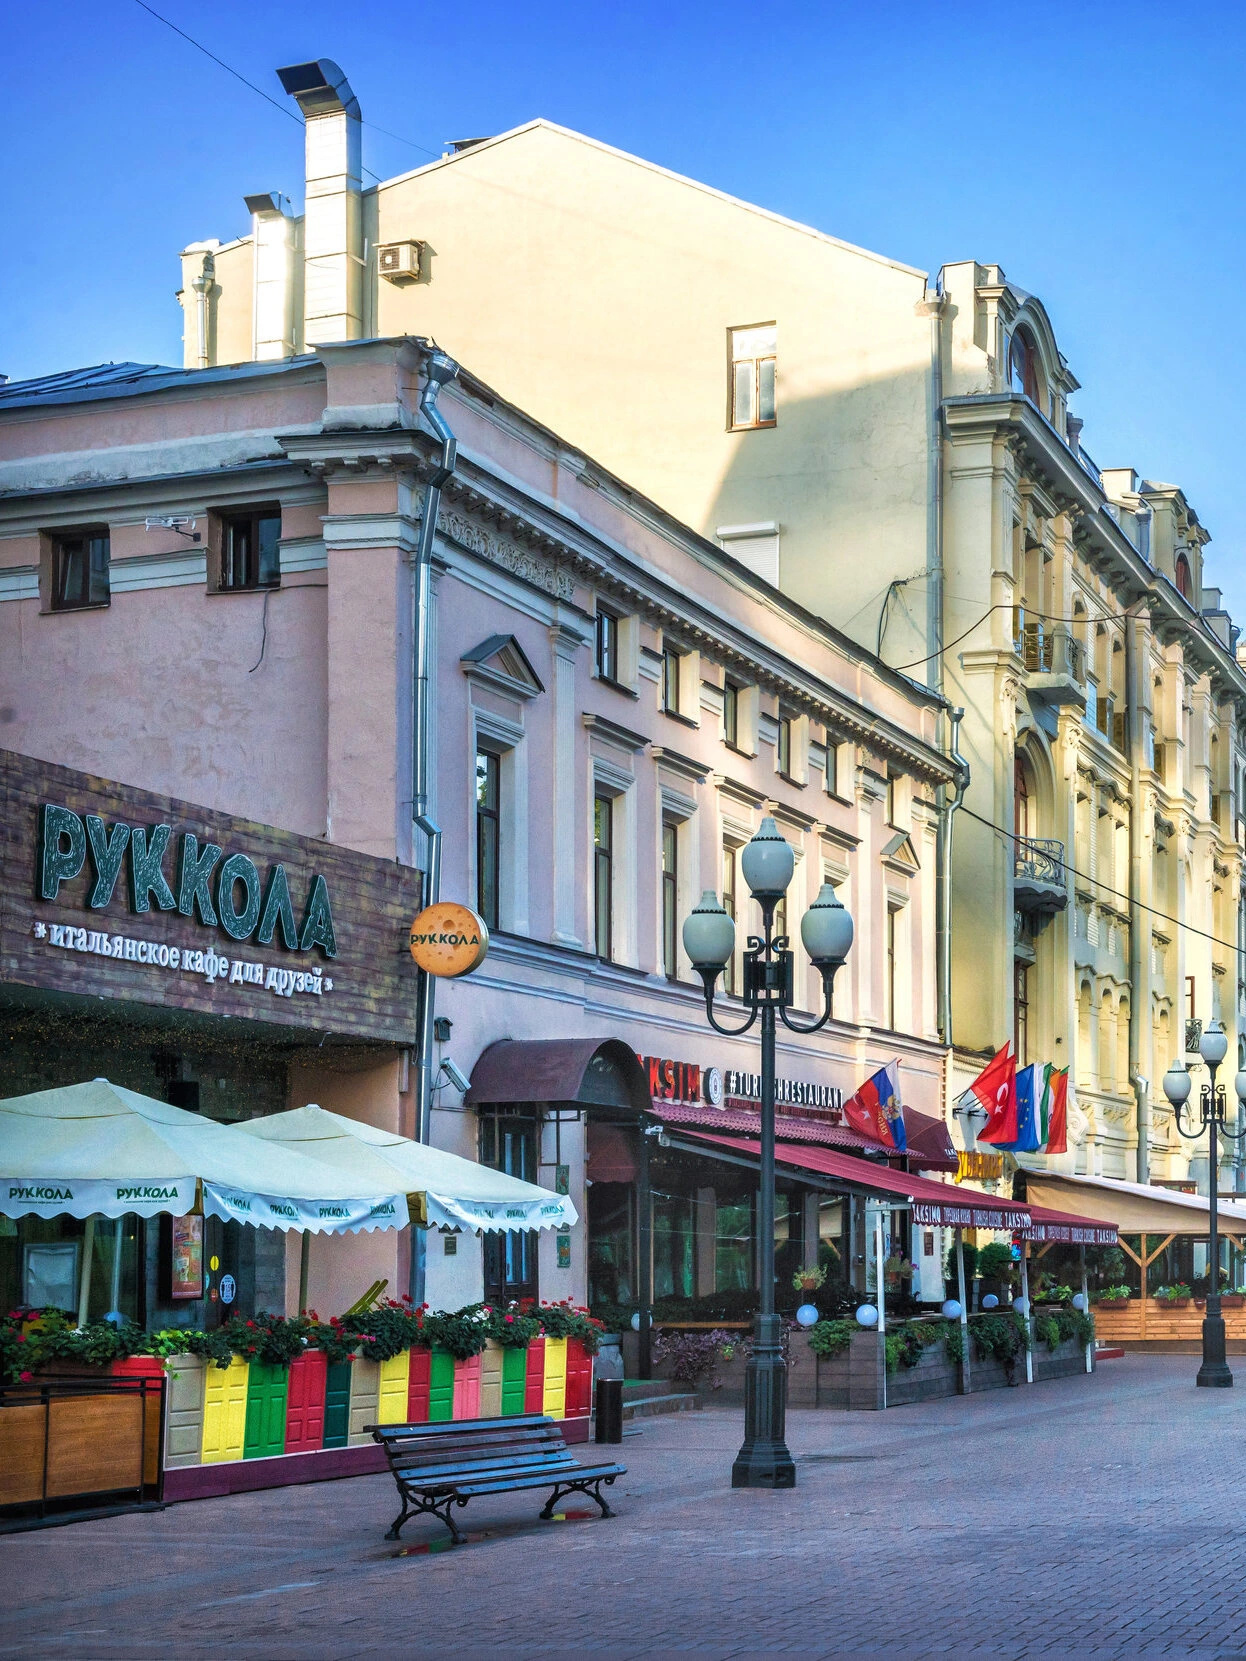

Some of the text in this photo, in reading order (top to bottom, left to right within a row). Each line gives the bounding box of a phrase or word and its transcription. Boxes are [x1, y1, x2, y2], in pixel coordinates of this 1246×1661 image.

[41, 804, 337, 958] РУККОЛА
[410, 933, 479, 945] РУККОЛА
[49, 922, 323, 997] итальянское кафе для друзей
[636, 1054, 700, 1102] KSIM
[729, 1070, 844, 1109] #TURHRESTAURANT
[9, 1187, 74, 1200] РУККОЛА
[116, 1186, 179, 1200] РУККОЛА
